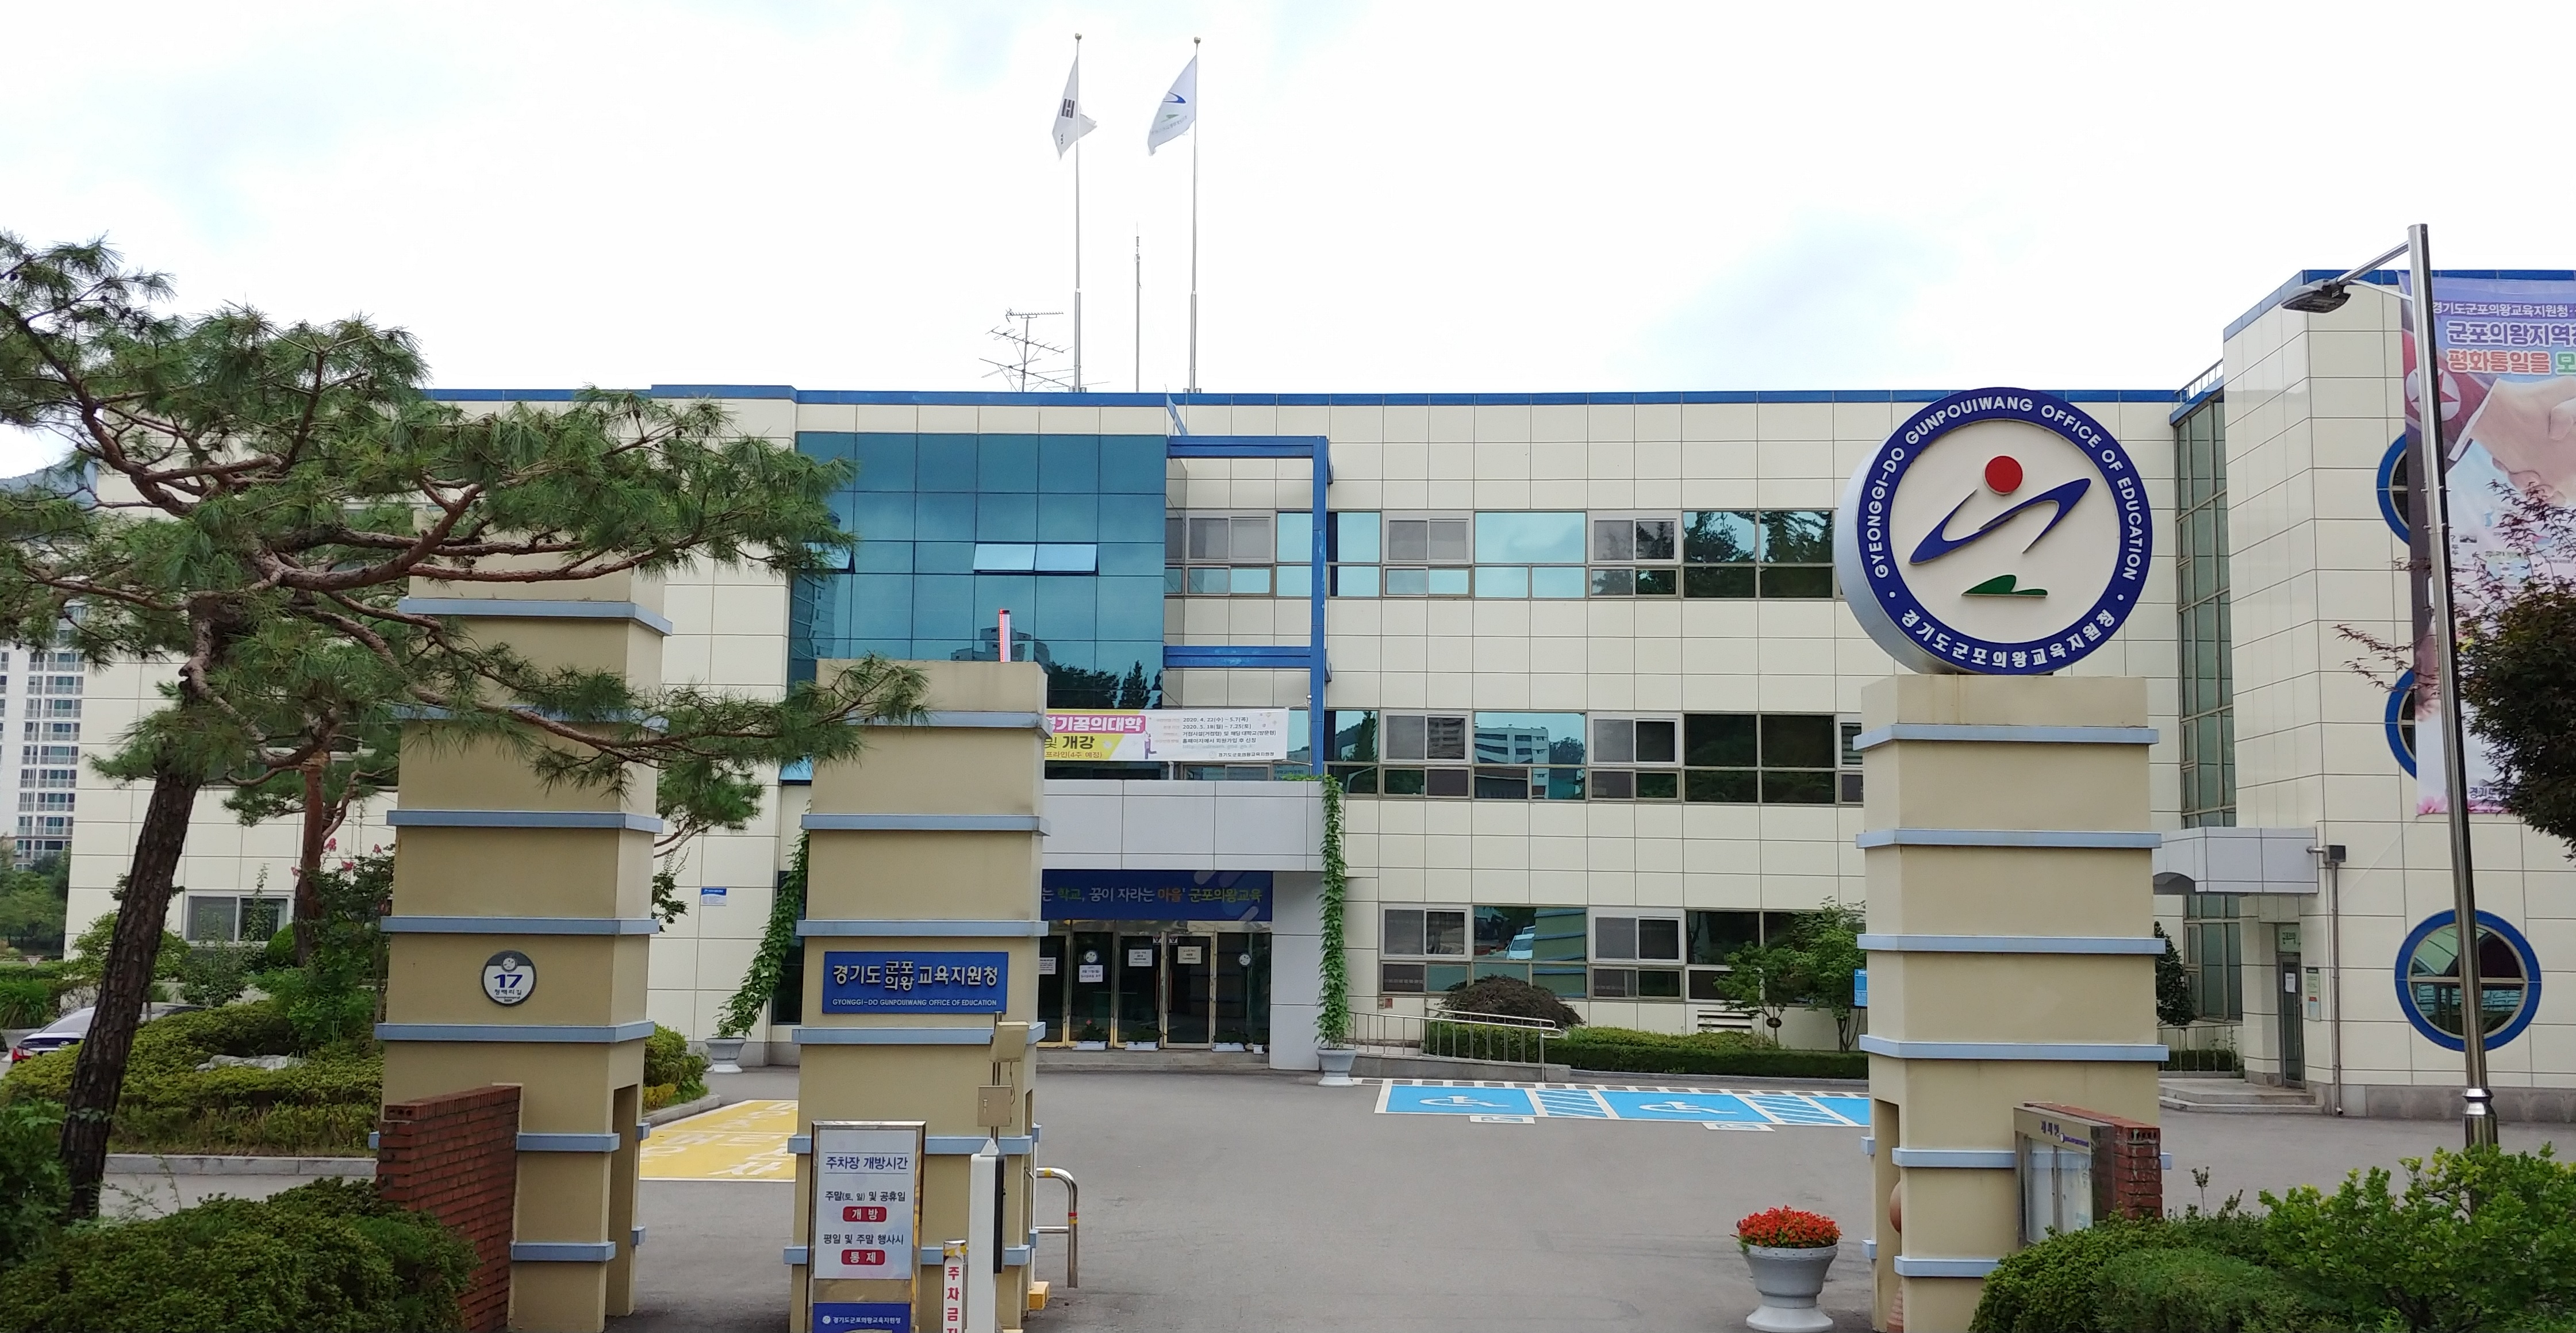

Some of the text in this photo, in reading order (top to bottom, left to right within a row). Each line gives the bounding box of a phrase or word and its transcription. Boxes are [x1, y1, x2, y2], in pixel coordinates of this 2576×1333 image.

[2432, 301, 2576, 317] 경기도군포의왕교육지원청·
[2448, 322, 2576, 345] 군포의왕지역
[2448, 350, 2550, 373] 평화통일을
[1867, 396, 2143, 581] GYEONGGI-DO GUNPOUIWANG OFFICE OF EDUCATION
[1901, 609, 2116, 668] 경기도군포의왕교육지원청
[1045, 735, 1095, 750] 및 개강
[2469, 786, 2500, 799] 경기도
[1089, 888, 1114, 902] 꿈이
[1118, 888, 1155, 902] 자라는
[1188, 888, 1263, 903] 군포의왕교육
[493, 974, 523, 989] 17
[832, 961, 999, 991] 경기도 군포 의왕 교육지원청
[826, 1156, 908, 1170] 주차장 개방시간
[869, 1190, 877, 1202] 및
[880, 1190, 905, 1202] 공휴일
[823, 1234, 904, 1246] 평일 및 주말 행사시
